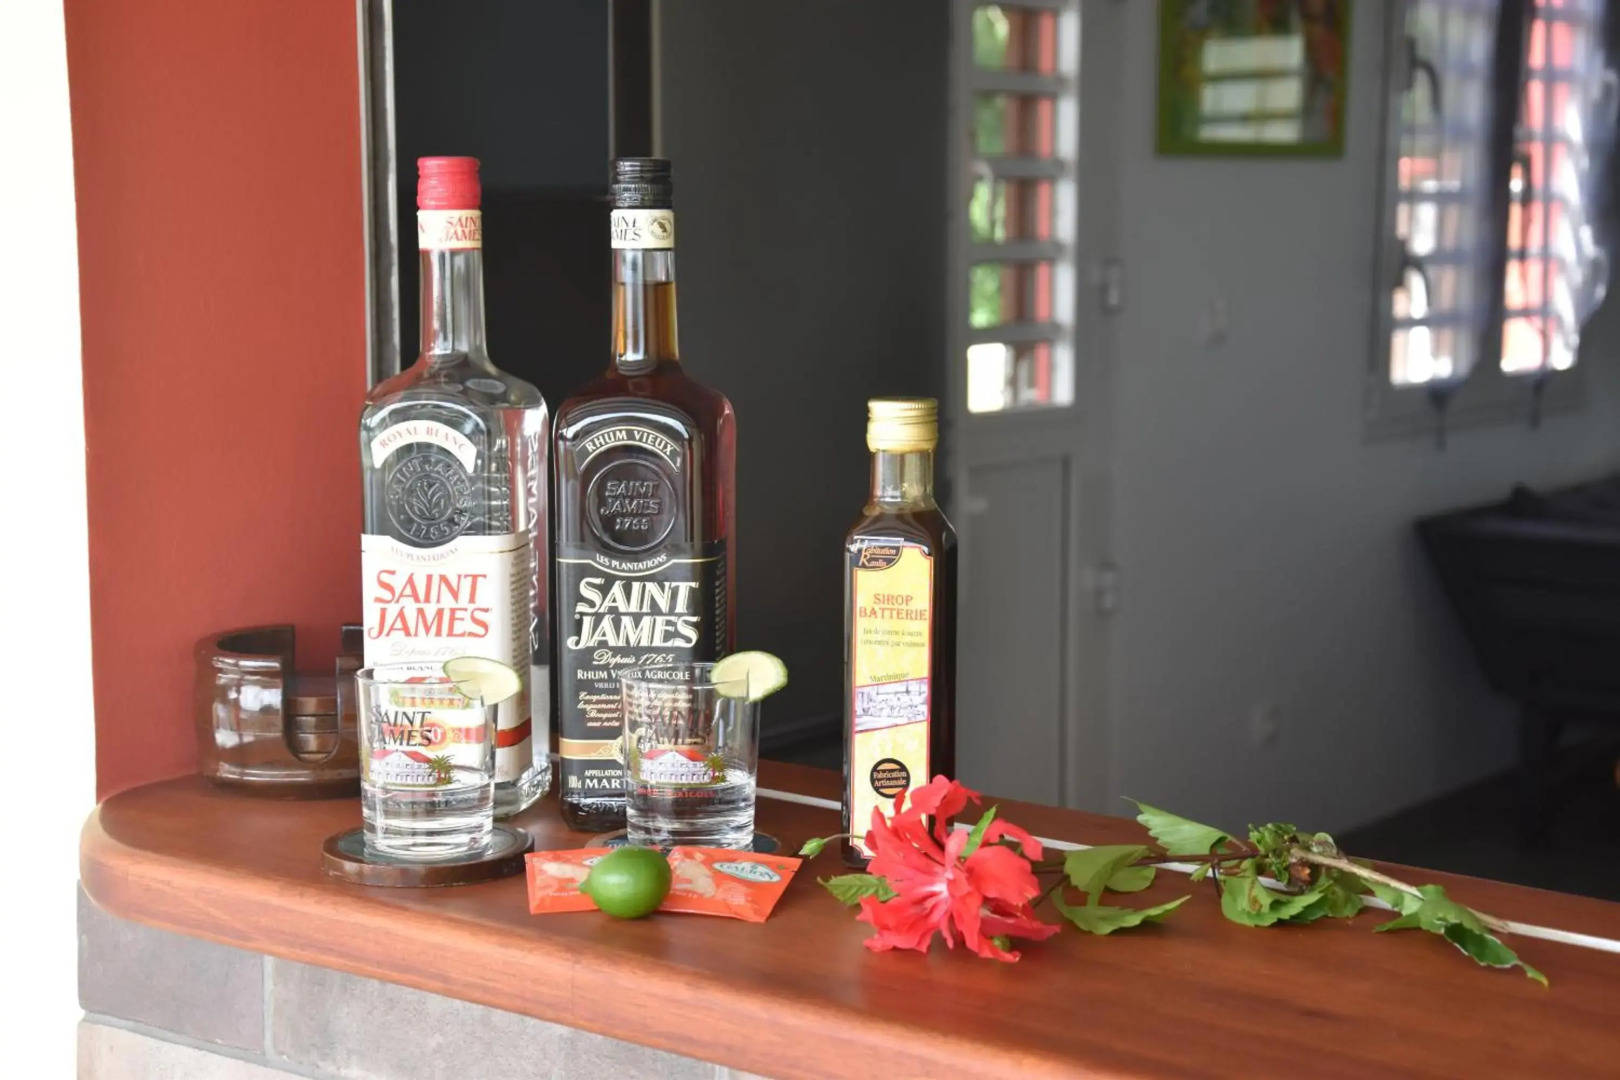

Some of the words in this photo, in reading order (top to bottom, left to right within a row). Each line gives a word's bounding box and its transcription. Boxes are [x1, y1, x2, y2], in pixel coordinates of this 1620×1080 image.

[585, 430, 628, 453] RHUM
[633, 430, 676, 456] VIEUX
[605, 481, 659, 497] SAINT
[599, 499, 661, 516] JAMES
[596, 553, 610, 566] LES
[612, 554, 668, 571] PLANTATIONS
[373, 569, 488, 604] SAINT
[575, 577, 700, 614] SAINT
[873, 593, 914, 606] SIROP
[859, 606, 929, 621] BATTERIE
[367, 606, 491, 640] JAMES
[566, 614, 702, 650] JAMES
[592, 649, 636, 668] Depuis
[637, 654, 675, 665] 1765
[577, 669, 609, 680] RHUM
[645, 669, 691, 681] AGRICOLE
[873, 770, 907, 779] Fabrication
